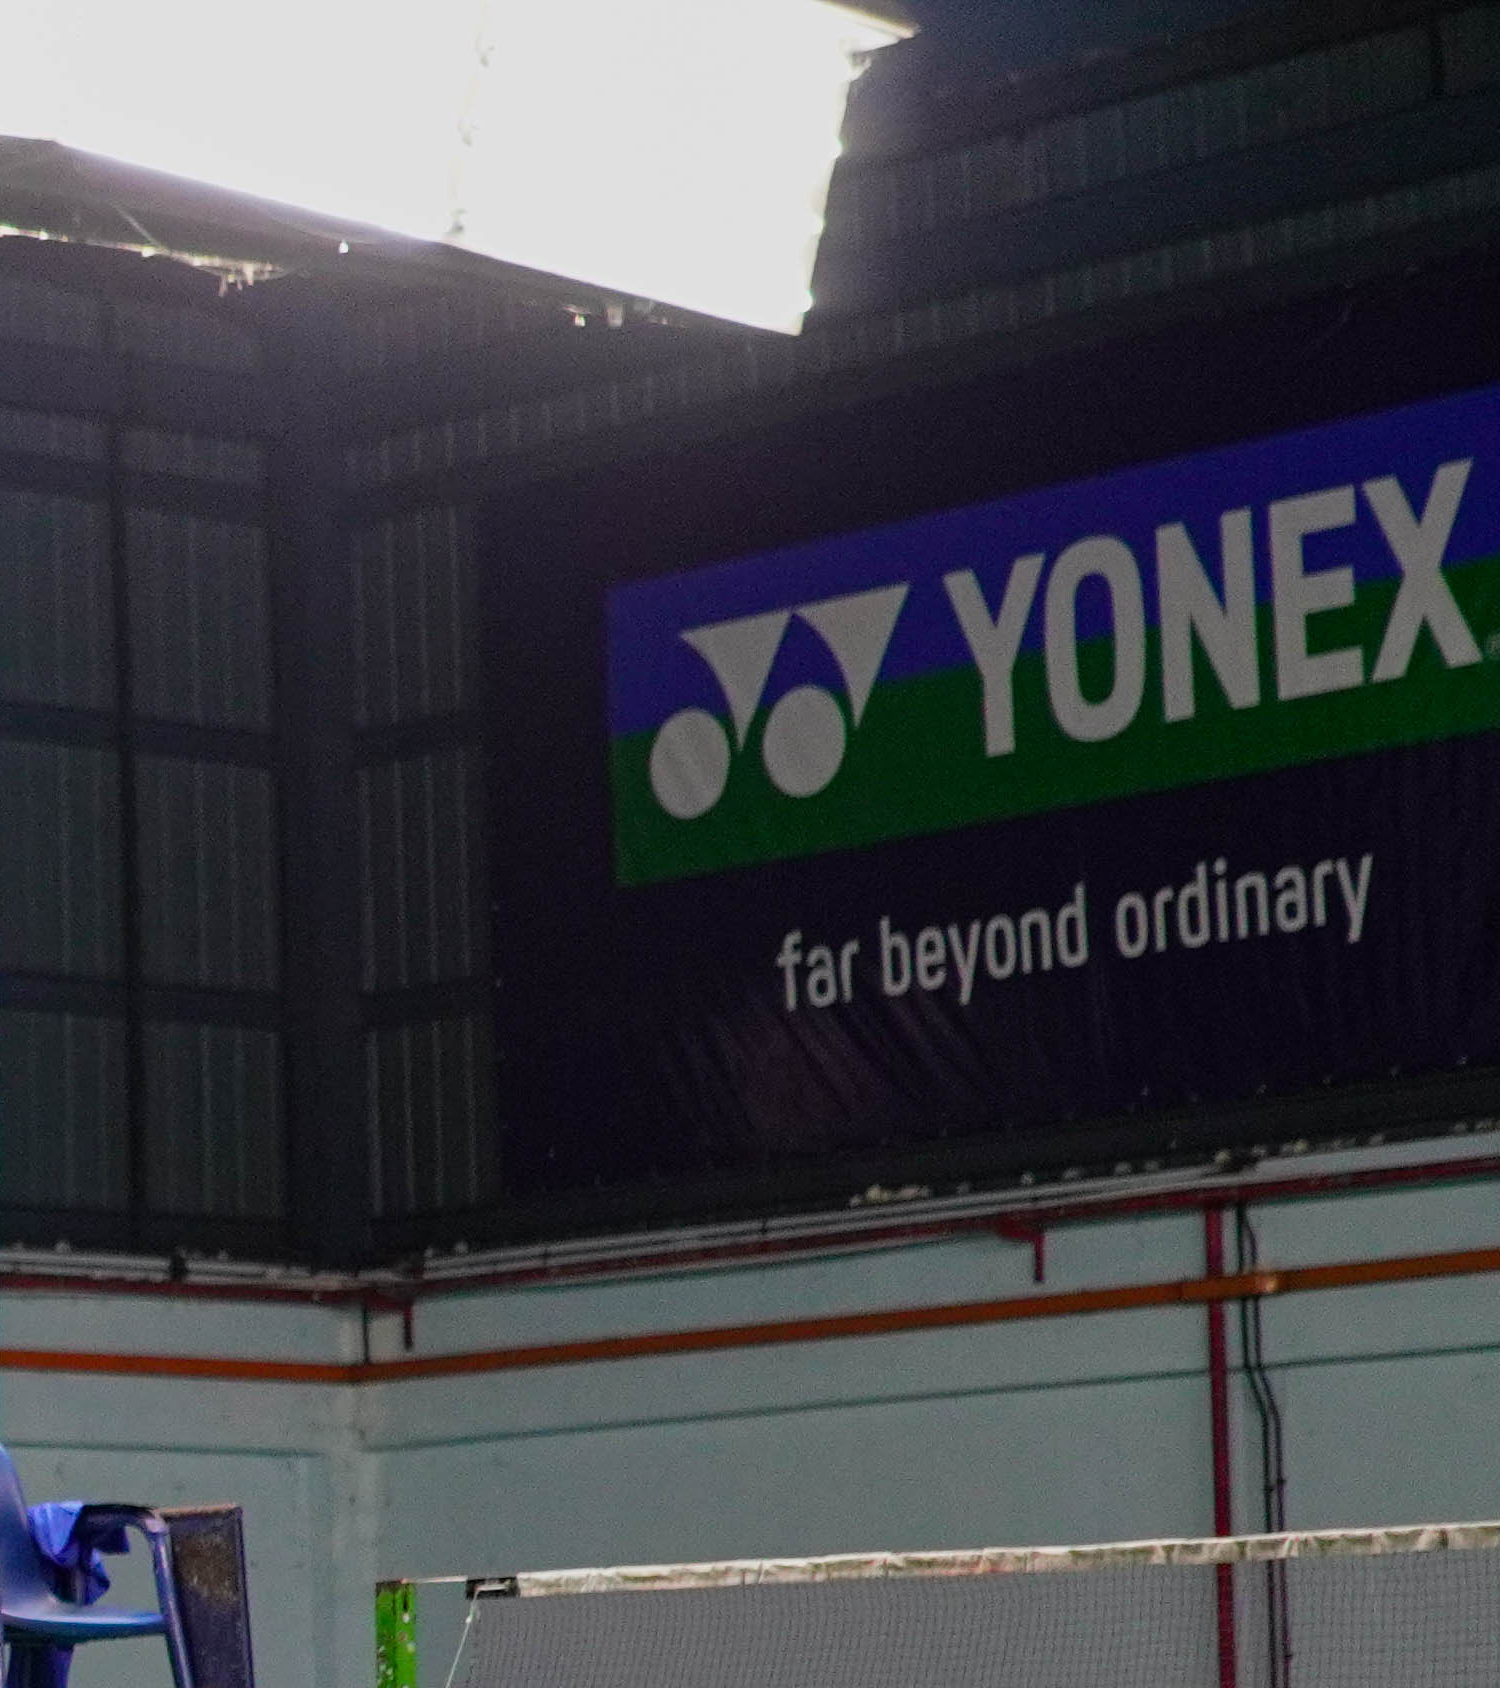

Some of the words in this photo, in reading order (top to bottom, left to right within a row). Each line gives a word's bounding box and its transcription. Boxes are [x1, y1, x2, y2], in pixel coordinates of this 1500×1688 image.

[943, 456, 1483, 760] YONEX
[778, 928, 861, 1013] far
[879, 882, 1089, 1006] beyond
[1115, 853, 1374, 958] ordinary
